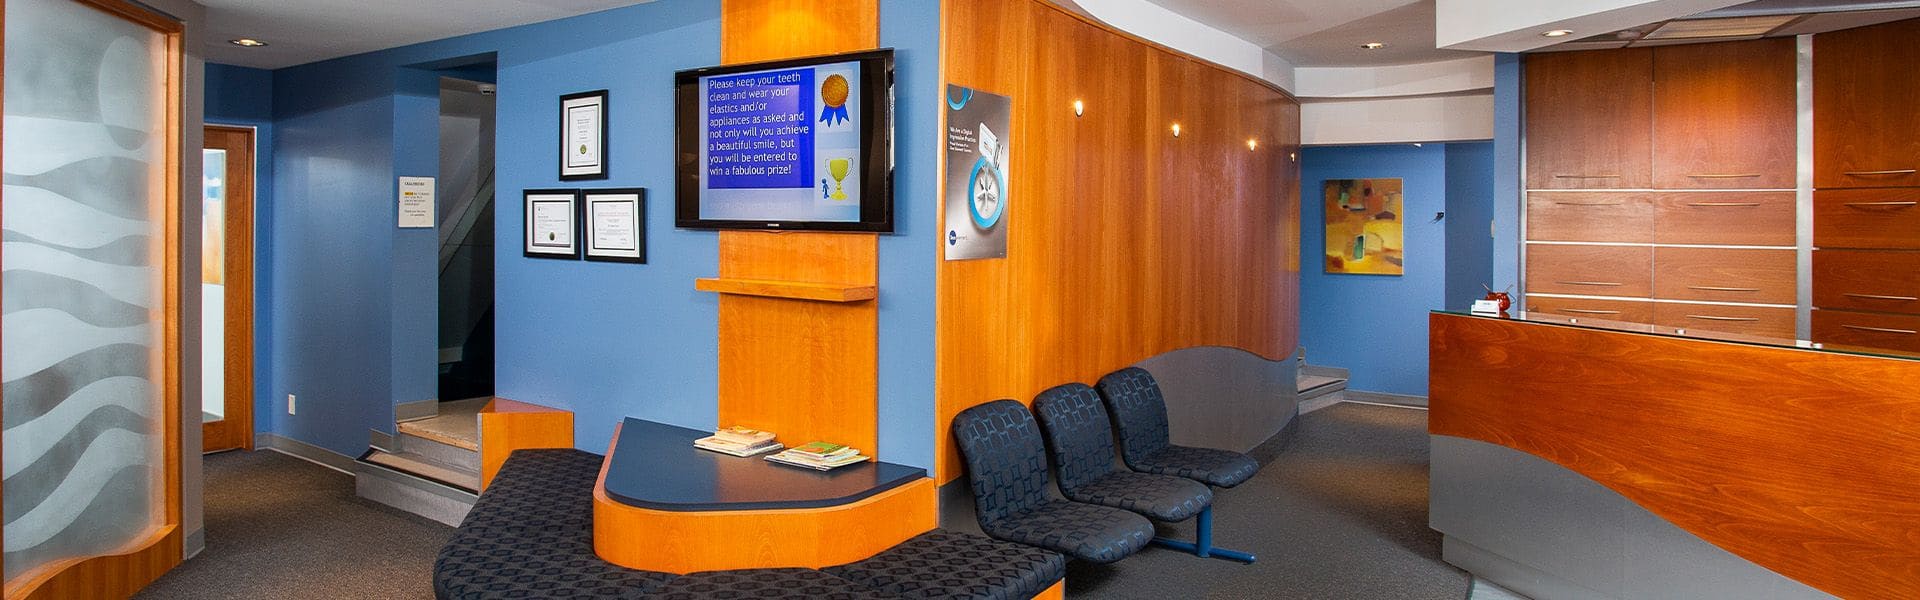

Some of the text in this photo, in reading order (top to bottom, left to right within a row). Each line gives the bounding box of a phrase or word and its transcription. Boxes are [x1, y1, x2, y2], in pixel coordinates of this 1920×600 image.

[709, 72, 800, 89] Please keep your teeth
[709, 87, 789, 101] clean and wear your
[709, 102, 767, 114] elastics and/or
[709, 111, 804, 127] appliances as asked and
[709, 125, 809, 139] not only will you achieve
[709, 138, 795, 151] a beautiful smile, but
[709, 152, 797, 165] you will be entered to
[709, 164, 792, 177] win a fabulous prize!
